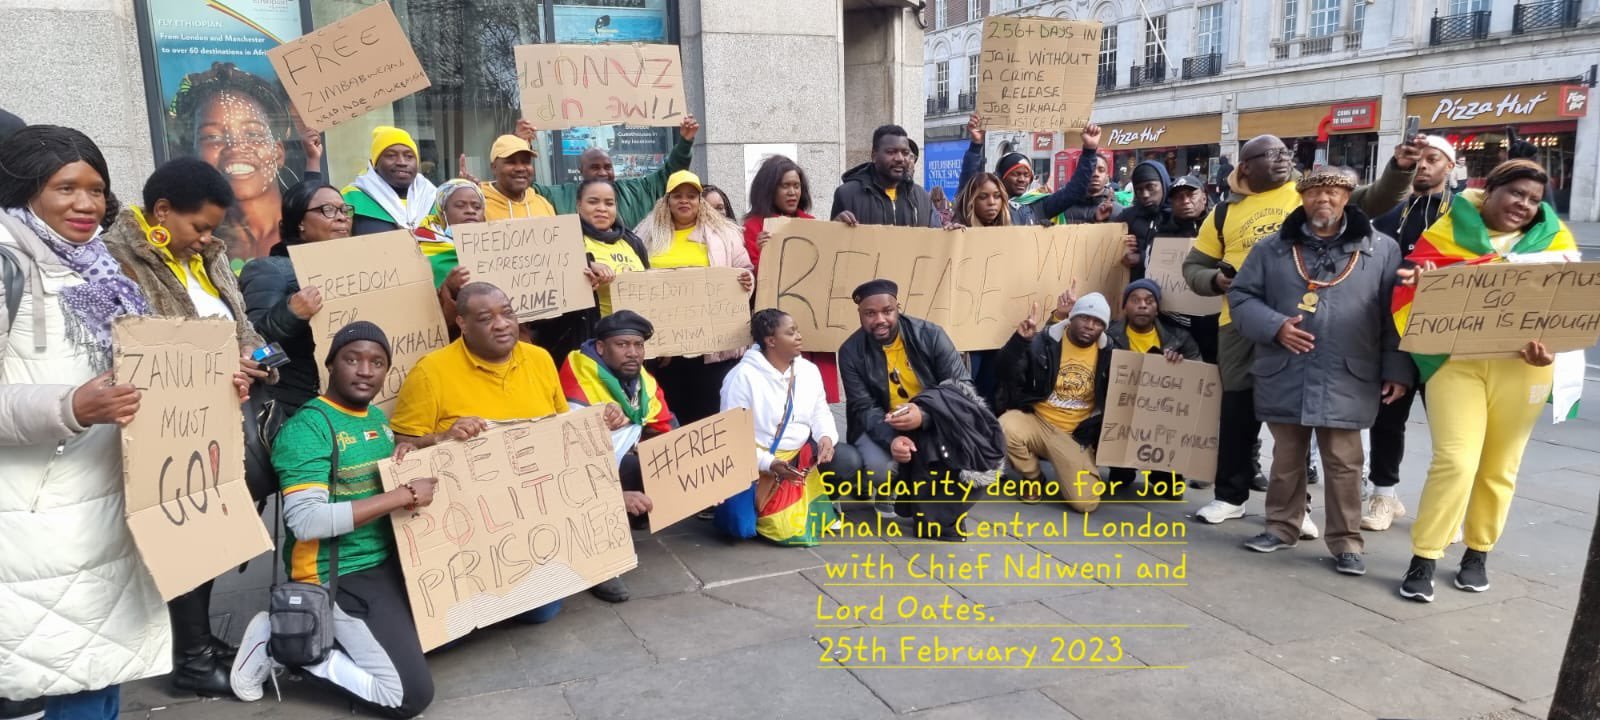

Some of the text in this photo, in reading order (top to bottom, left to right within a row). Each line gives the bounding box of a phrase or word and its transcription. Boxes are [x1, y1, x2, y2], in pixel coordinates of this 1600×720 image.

[181, 33, 209, 41] London
[224, 35, 265, 43] Manchester
[987, 21, 1098, 41] 256+ DAYS IN
[200, 47, 243, 55] destinations
[282, 25, 380, 86] FREE
[982, 69, 994, 83] A
[1001, 86, 1061, 100] RELEASE
[536, 95, 583, 121] UP
[983, 101, 1067, 114] JOB SIKHALA
[1431, 90, 1548, 123] Pizza Hut
[1108, 125, 1166, 146] Pizza Hut
[461, 226, 560, 255] FREEDOM OF
[477, 252, 570, 274] EXPRESSION IS
[308, 268, 400, 302] FREEDOM
[511, 270, 555, 289] NOT A
[1405, 312, 1485, 336] ENOUGH
[1519, 310, 1600, 330] ENOUGH
[123, 350, 225, 391] ZANU PF
[1115, 364, 1184, 390] ENOUGH
[1117, 392, 1190, 417] ENOUGH
[160, 405, 210, 438] MUST
[1103, 422, 1151, 443] ZANU
[1155, 424, 1177, 445] PF
[390, 427, 539, 491] FREE
[647, 418, 727, 481] #FREE
[677, 454, 735, 492] WIWA
